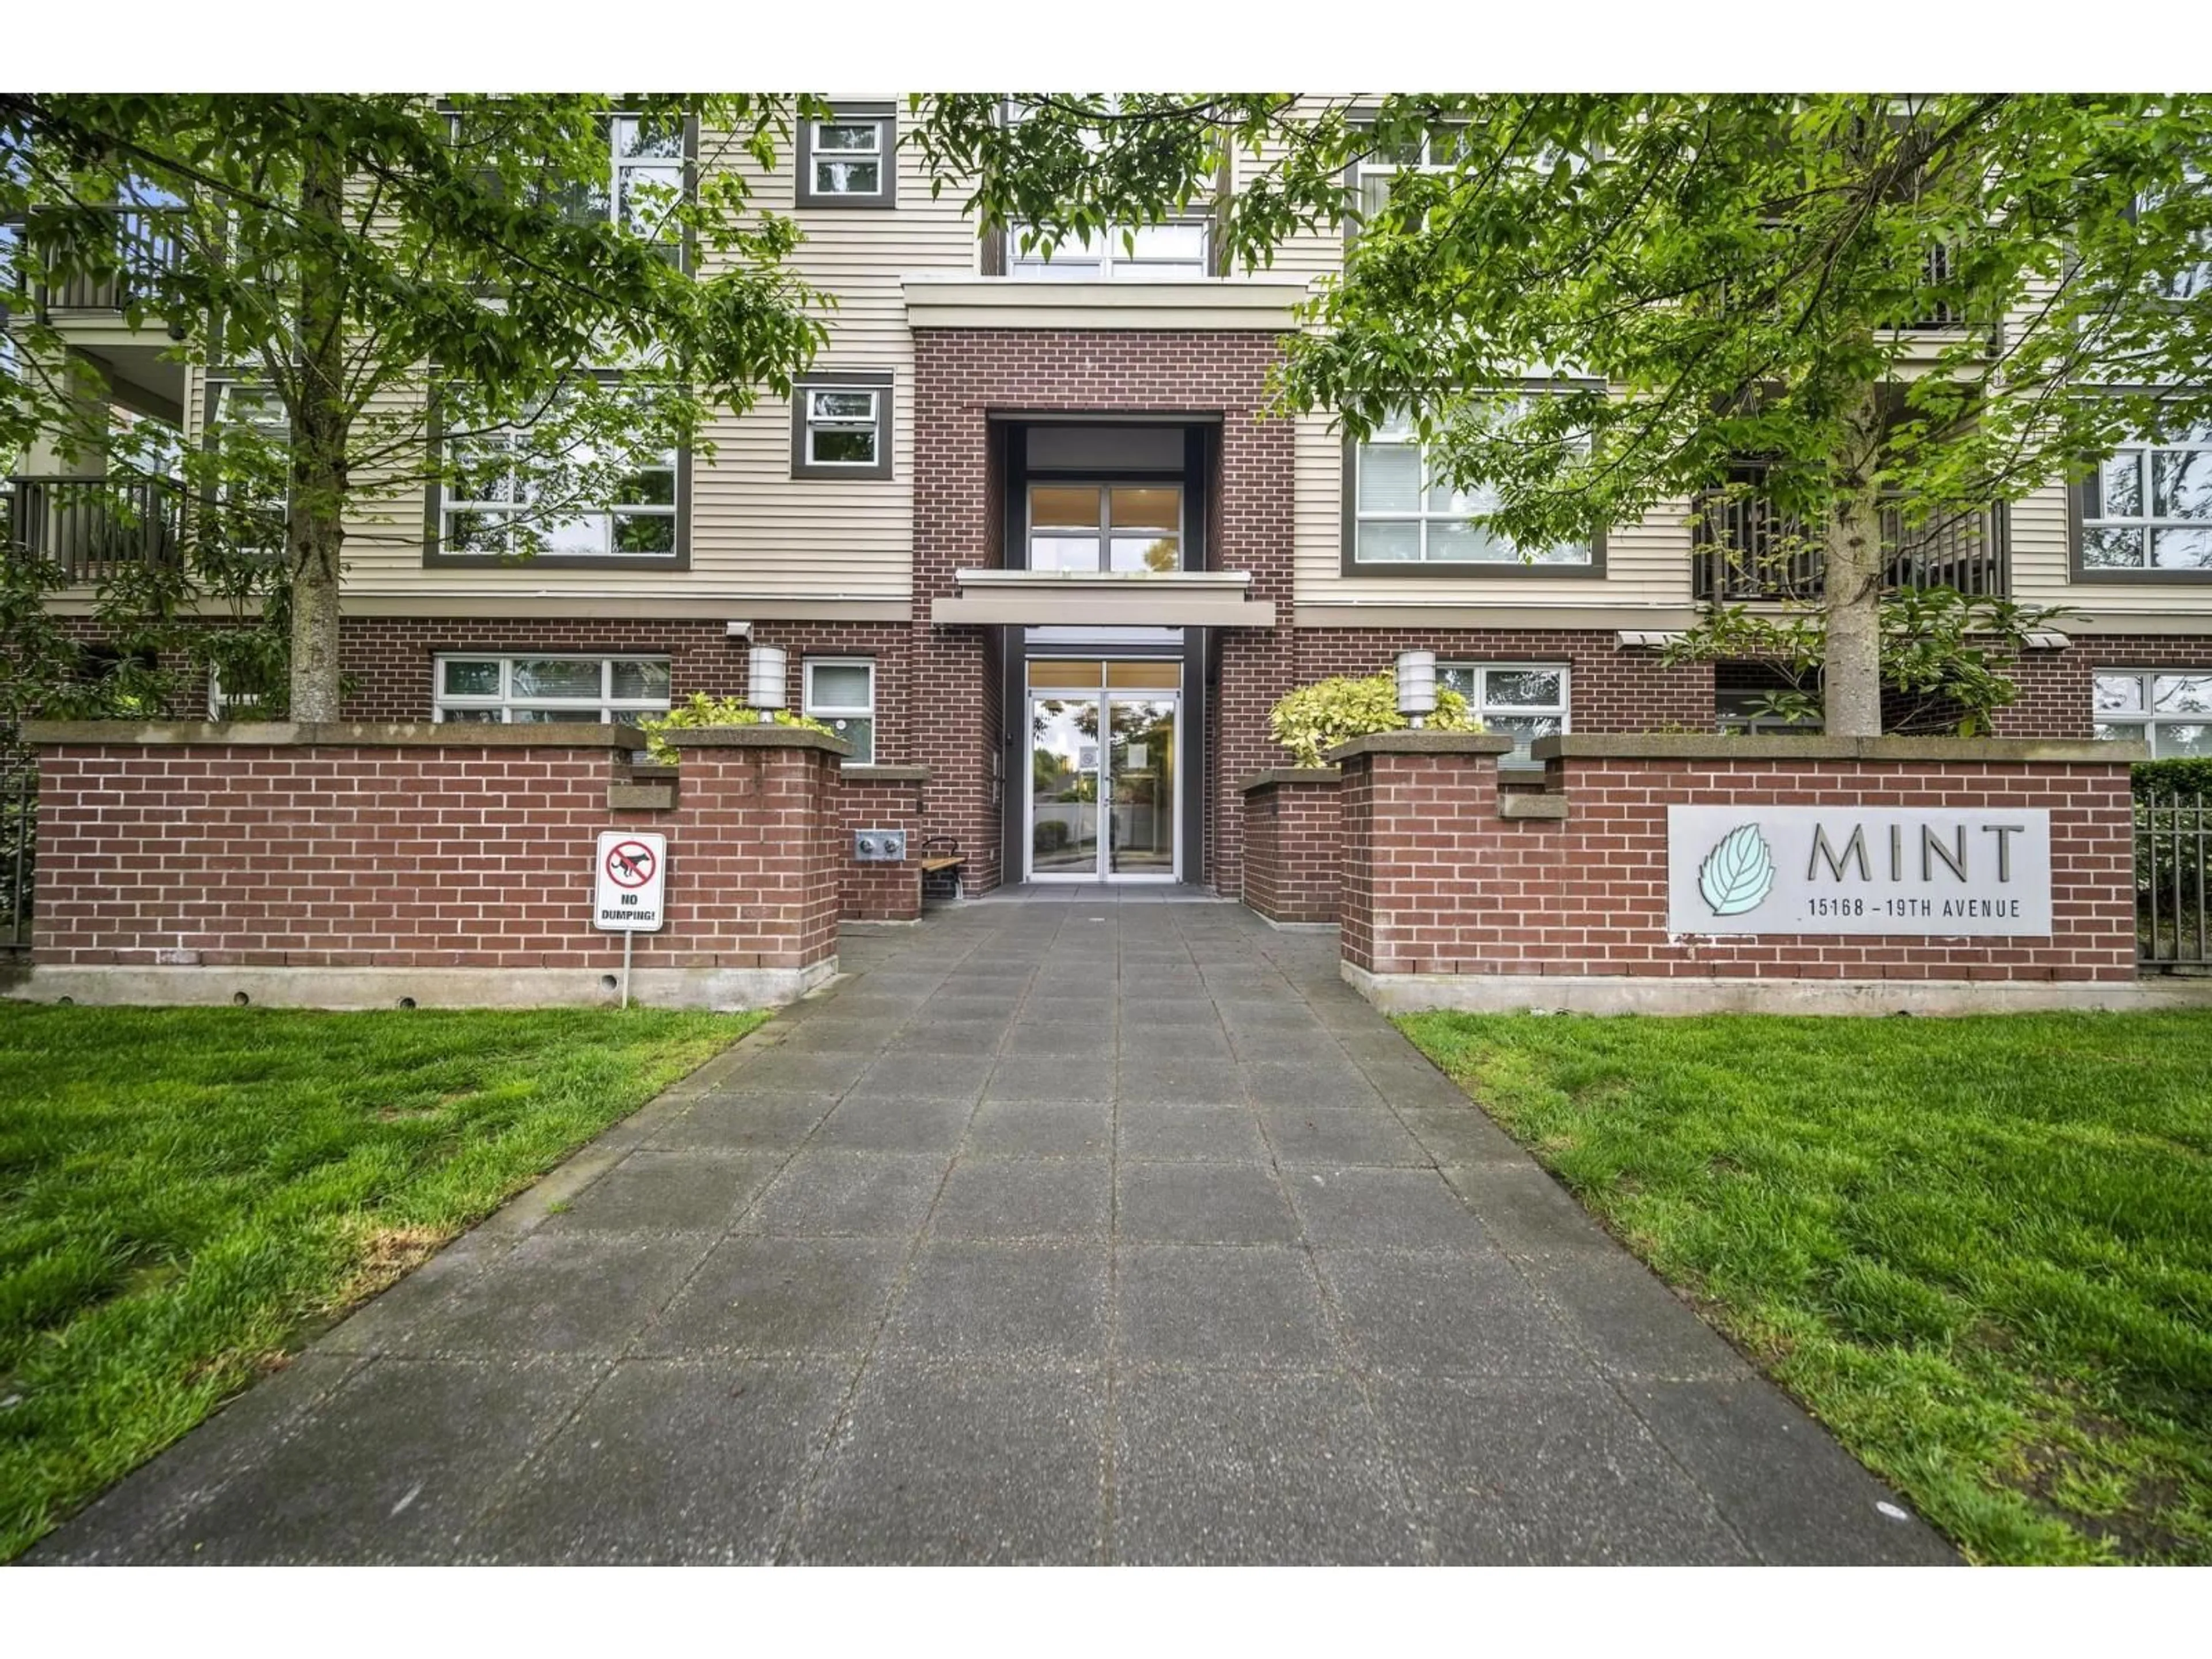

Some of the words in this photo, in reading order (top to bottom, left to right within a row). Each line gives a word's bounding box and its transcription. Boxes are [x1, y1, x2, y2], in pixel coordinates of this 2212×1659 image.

[1808, 823, 2025, 883] MINT
[621, 894, 638, 905] NO
[601, 910, 656, 921] DUMPING!
[1943, 899, 2020, 918] AVENUE
